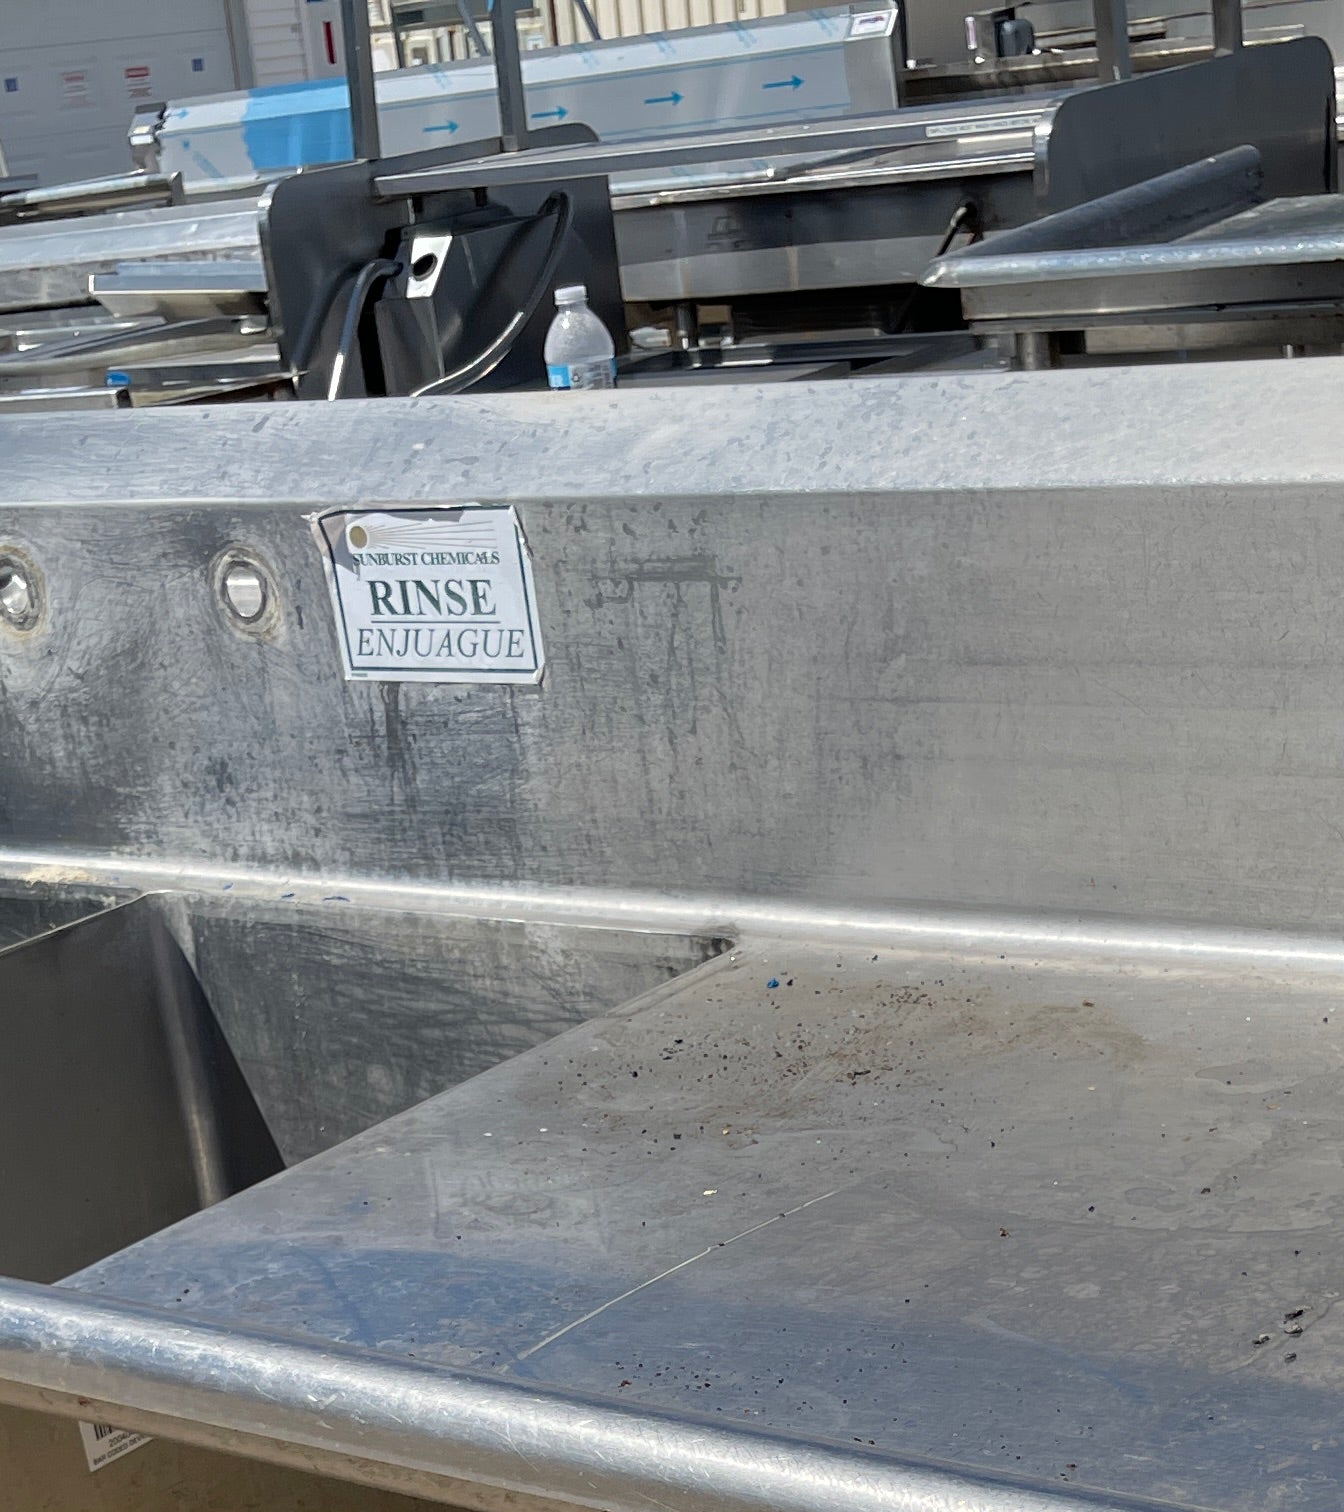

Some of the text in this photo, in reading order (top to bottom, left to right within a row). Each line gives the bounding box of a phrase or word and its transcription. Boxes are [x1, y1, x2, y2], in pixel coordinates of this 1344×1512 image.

[353, 551, 500, 566] SUNBURST CHEMICALS
[367, 578, 497, 617] RINSE
[357, 628, 525, 658] ENJUAGUE
